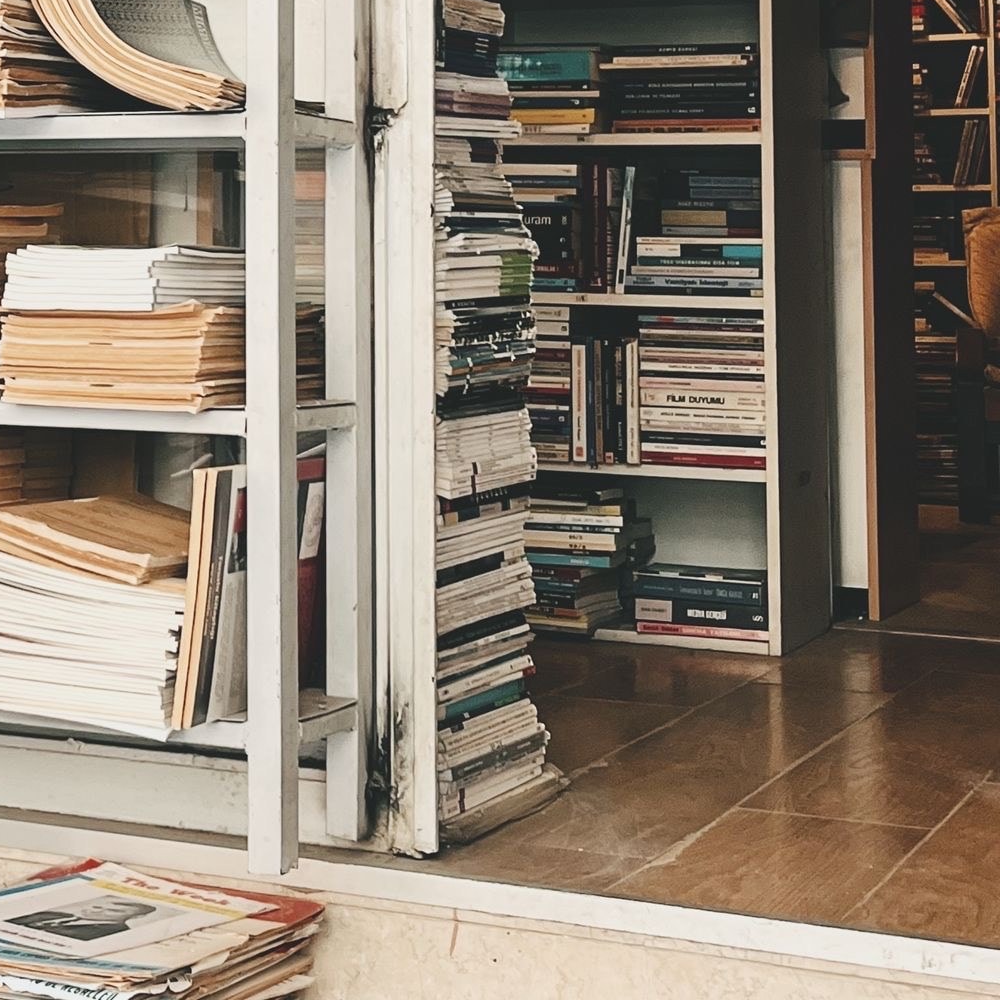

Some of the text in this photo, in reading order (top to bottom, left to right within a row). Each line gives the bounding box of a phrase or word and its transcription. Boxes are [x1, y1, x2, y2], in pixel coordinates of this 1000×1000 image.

[524, 215, 551, 225] uram
[666, 394, 725, 405] FİLM DUYUMU
